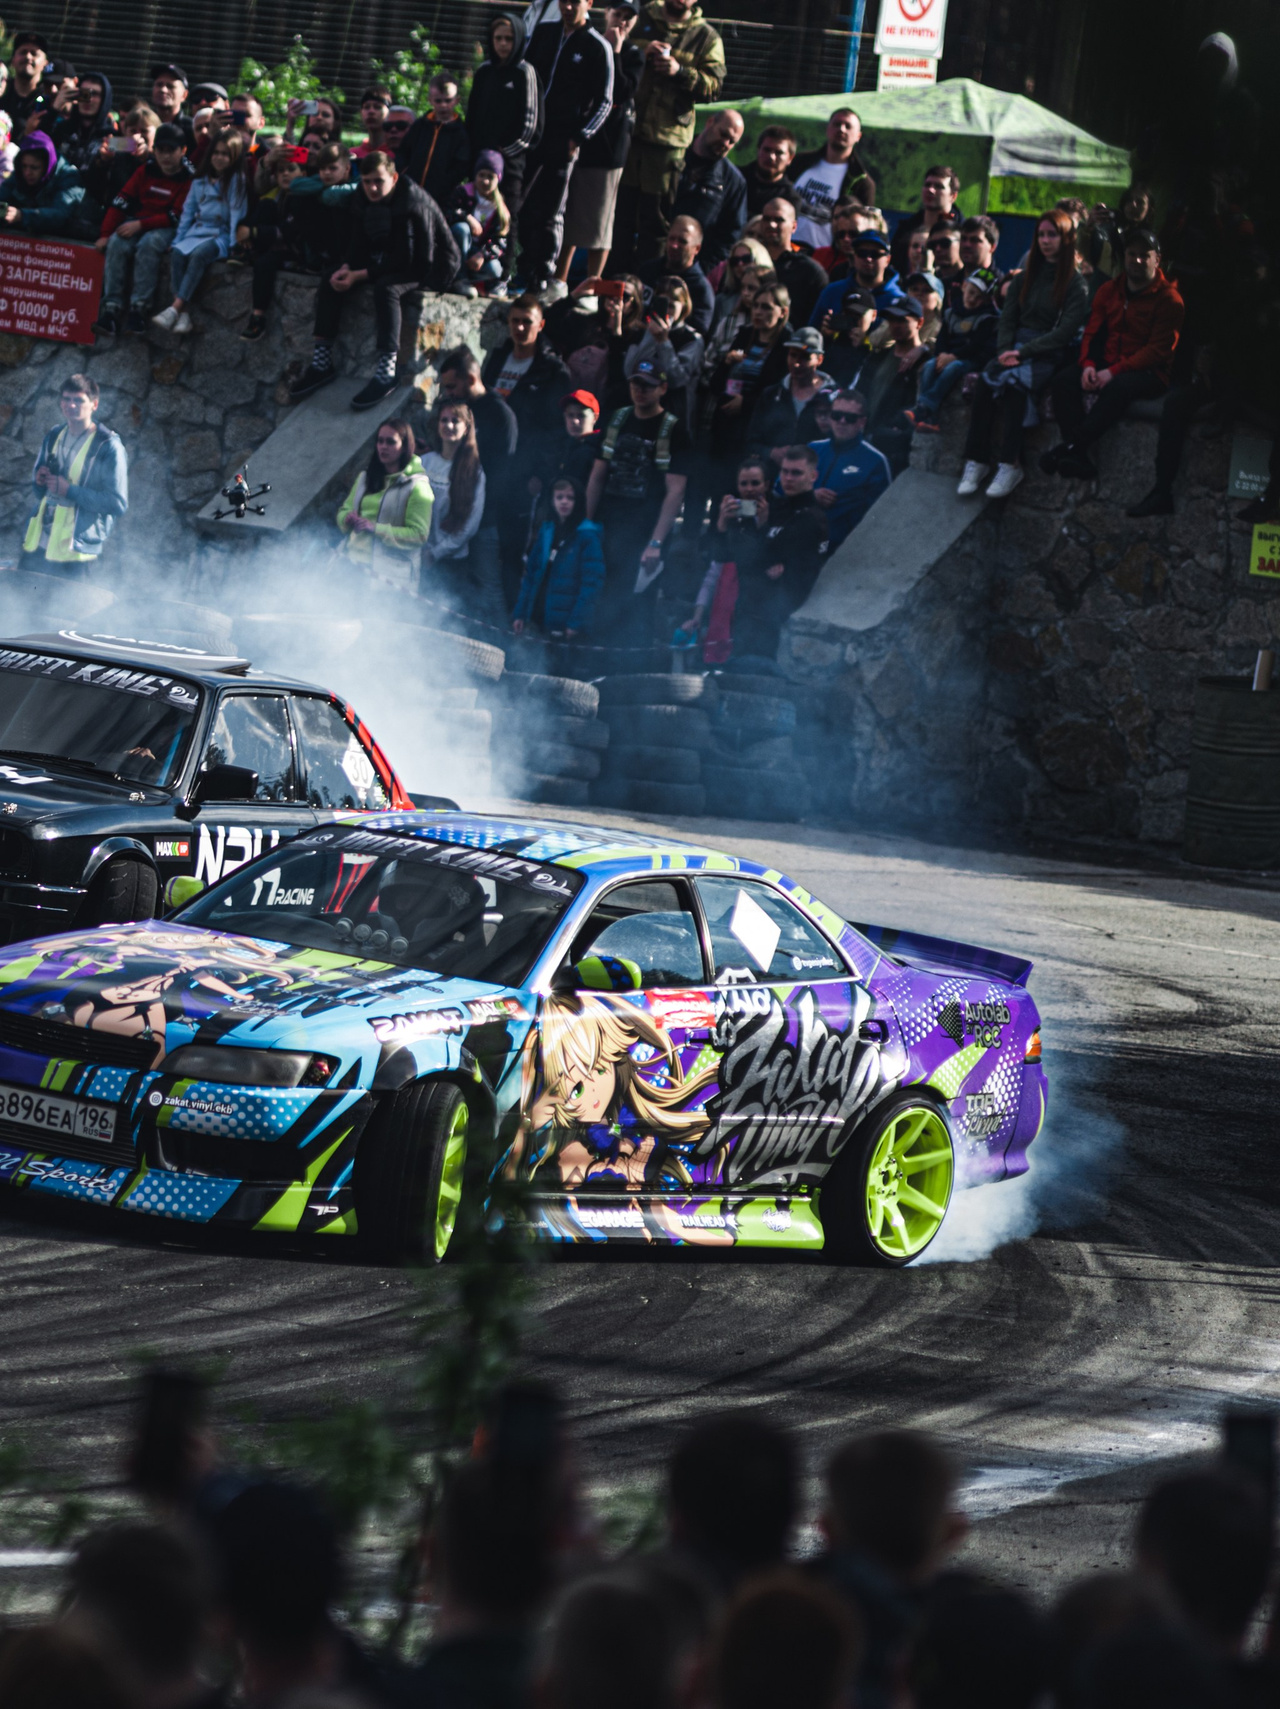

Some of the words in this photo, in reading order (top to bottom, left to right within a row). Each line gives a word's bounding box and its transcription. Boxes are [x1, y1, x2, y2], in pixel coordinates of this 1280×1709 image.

[23, 255, 72, 270] фонарики
[6, 265, 93, 292] ЗАПРЕЩЕНЫ
[3, 285, 55, 300] нарушении
[12, 300, 50, 318] 10000
[51, 308, 80, 325] руб.
[15, 319, 38, 333] МВД
[39, 324, 46, 333] и
[47, 323, 69, 338] МЧС
[68, 663, 174, 696] KING
[349, 755, 370, 784] 30
[327, 831, 439, 857] DRIFT
[423, 845, 542, 881] KING
[274, 887, 315, 905] RACING
[965, 998, 1011, 1024] Autolab
[974, 1024, 1003, 1049] RCC
[164, 1096, 233, 1115] zakat.vinyl.ekb
[966, 1094, 995, 1114] TOP
[78, 1106, 109, 1131] 196
[82, 1126, 99, 1137] RUS
[19, 1160, 114, 1192] Sports
[585, 1210, 639, 1228] GARAGE
[677, 1214, 726, 1229] TRAILHEAD
